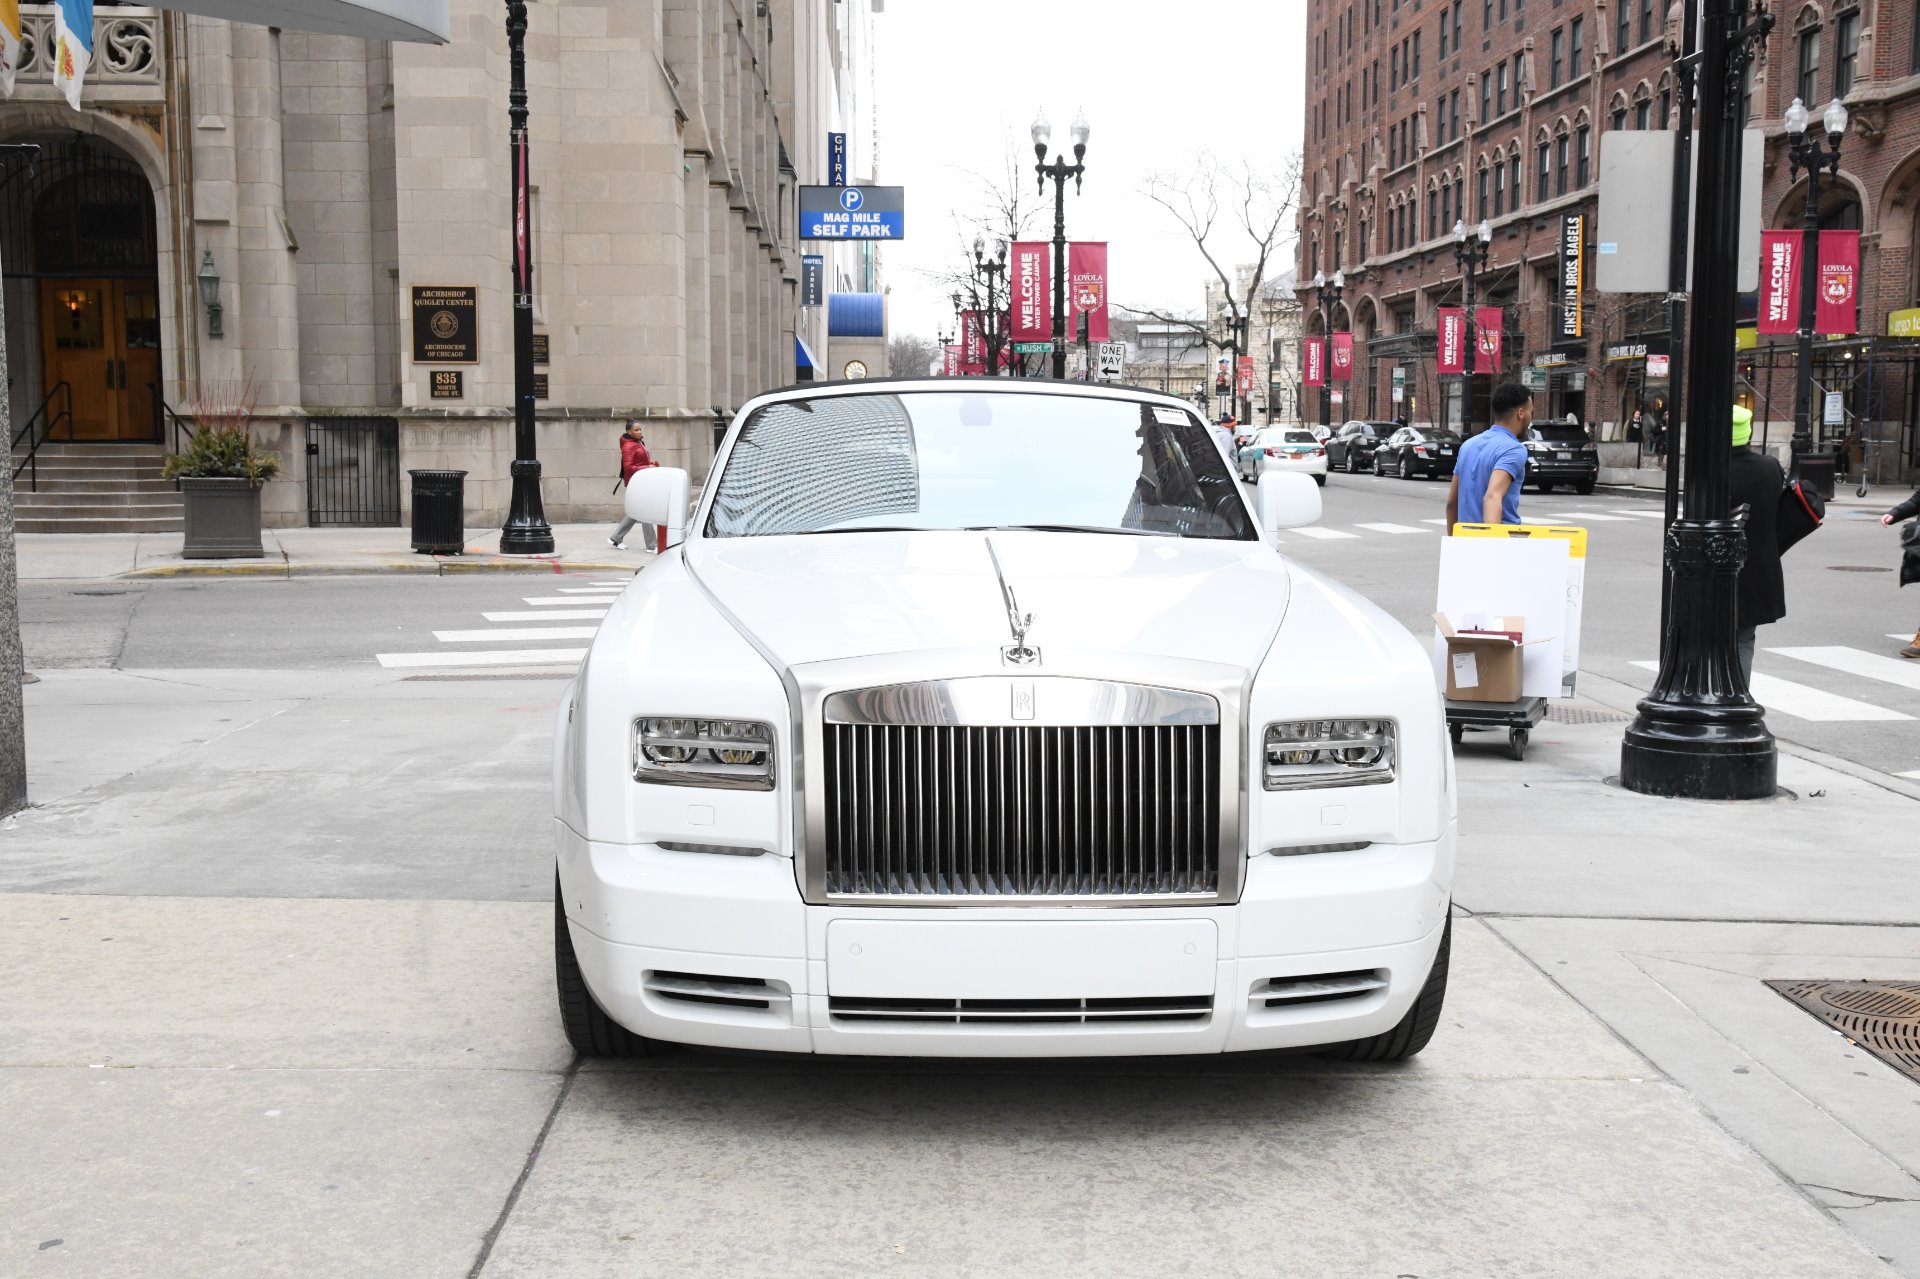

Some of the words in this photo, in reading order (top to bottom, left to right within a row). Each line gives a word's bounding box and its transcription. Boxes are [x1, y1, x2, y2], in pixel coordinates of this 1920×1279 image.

[823, 213, 850, 223] MAG
[852, 213, 881, 223] MILE
[812, 224, 848, 236] SELF
[851, 224, 891, 236] PARK
[1567, 217, 1580, 256] BAGELS
[1784, 243, 1792, 272] CAMPUS
[1022, 253, 1033, 329] WELCOME
[1769, 242, 1785, 321] WELCOME
[421, 290, 466, 298] ARCHBISHOP
[1564, 289, 1577, 335] EINSTEIN
[1781, 298, 1789, 321] WATER
[1101, 345, 1122, 356] ONE
[1444, 316, 1453, 365] WELCOME
[1100, 355, 1121, 365] WAY
[436, 373, 457, 384] 835
